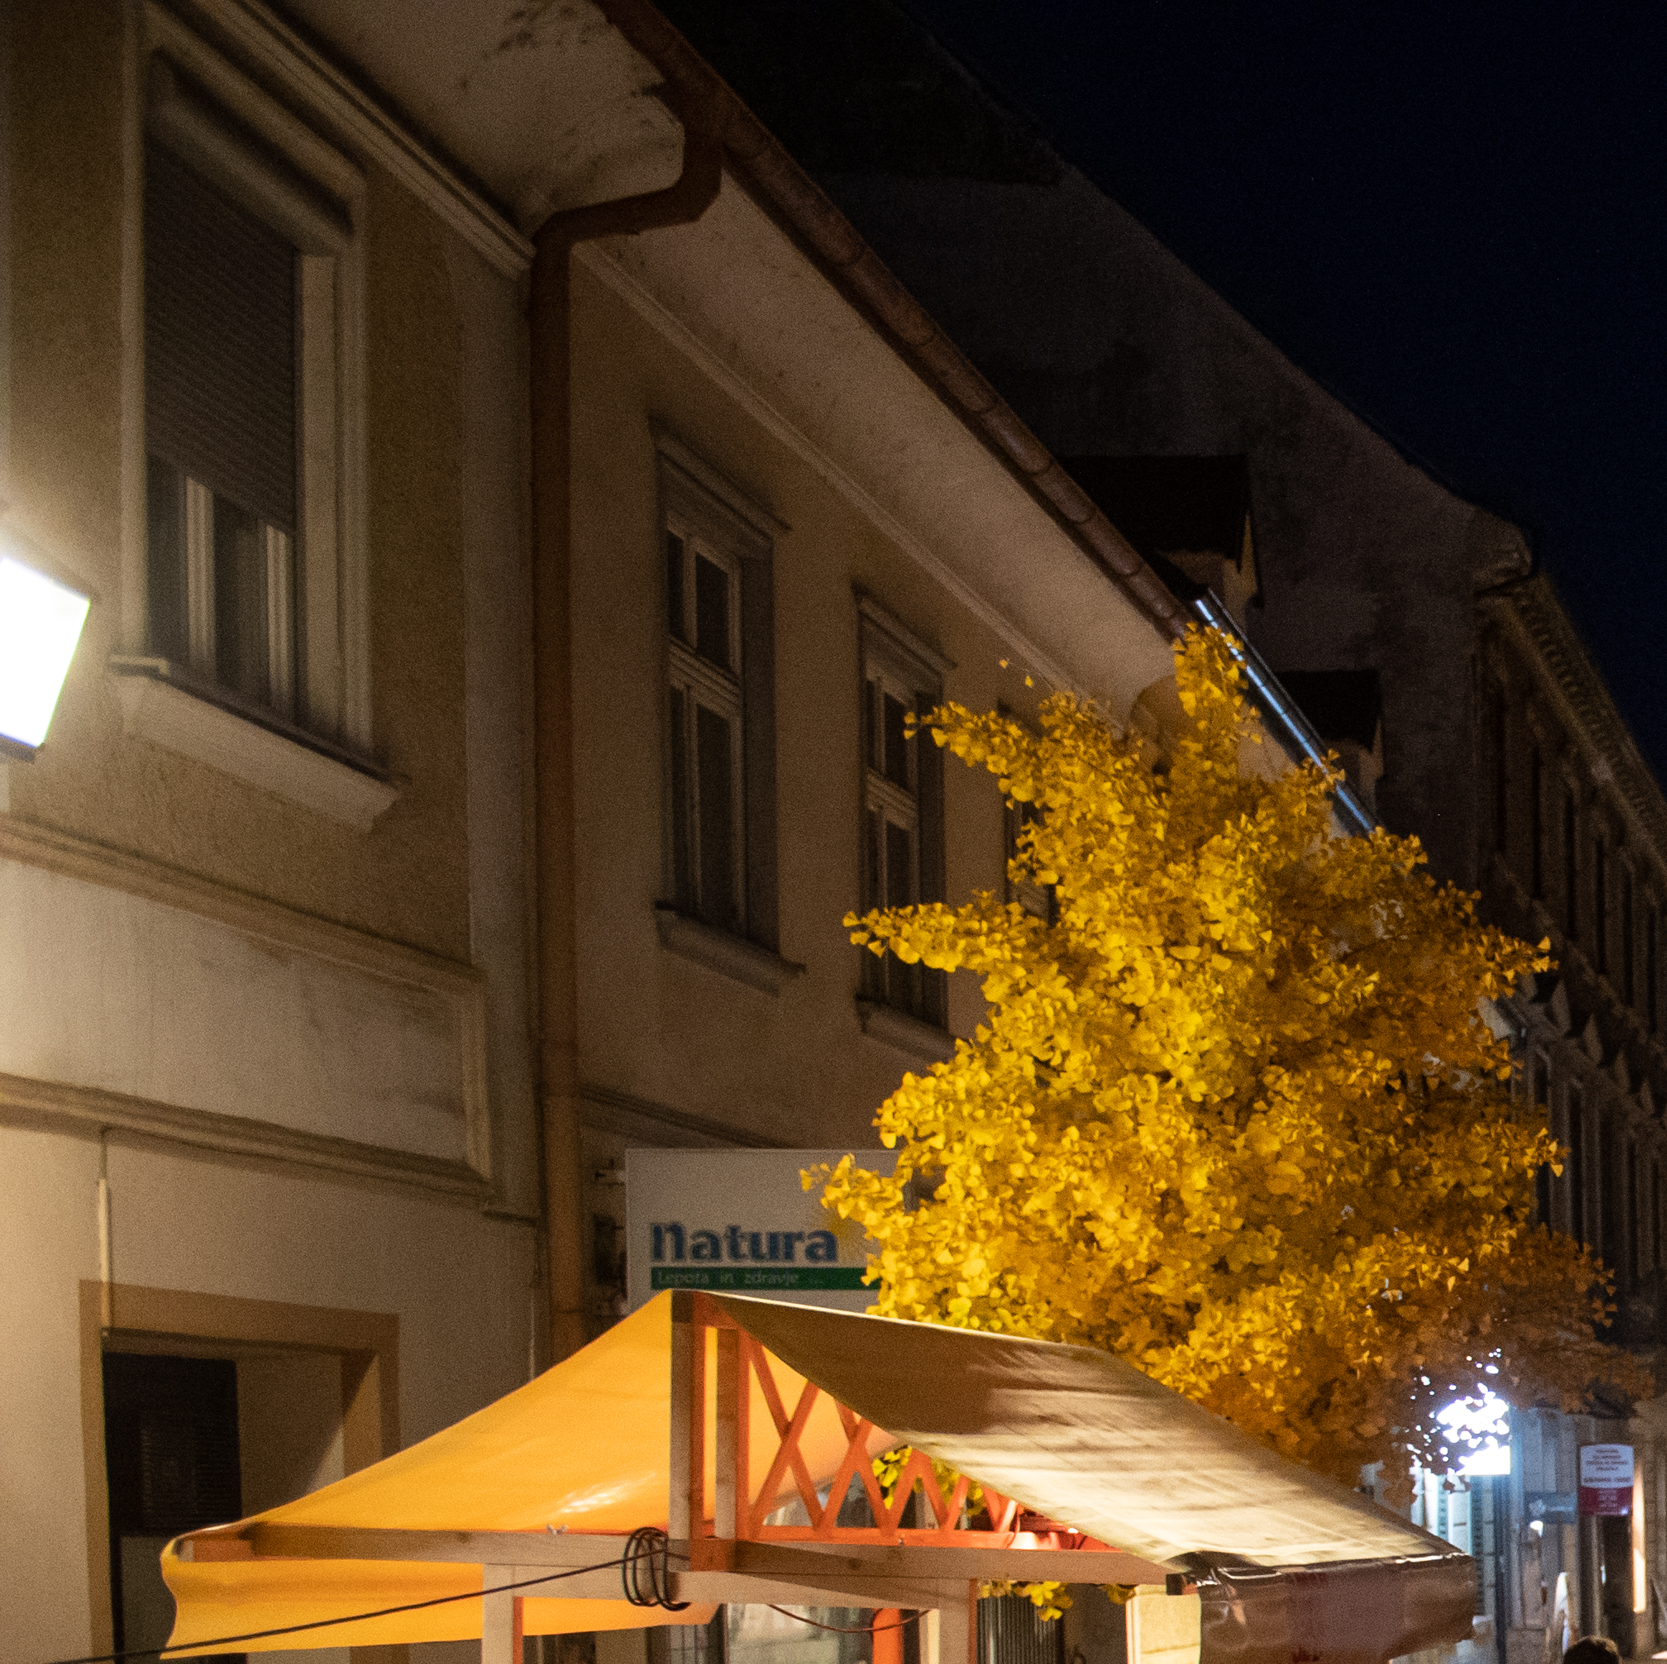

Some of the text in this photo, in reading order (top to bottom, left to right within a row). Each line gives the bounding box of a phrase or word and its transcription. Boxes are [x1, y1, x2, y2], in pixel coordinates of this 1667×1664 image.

[651, 1221, 838, 1263] natura
[657, 1270, 710, 1286] Lepota
[719, 1270, 735, 1285] in
[743, 1270, 800, 1287] zdravje
